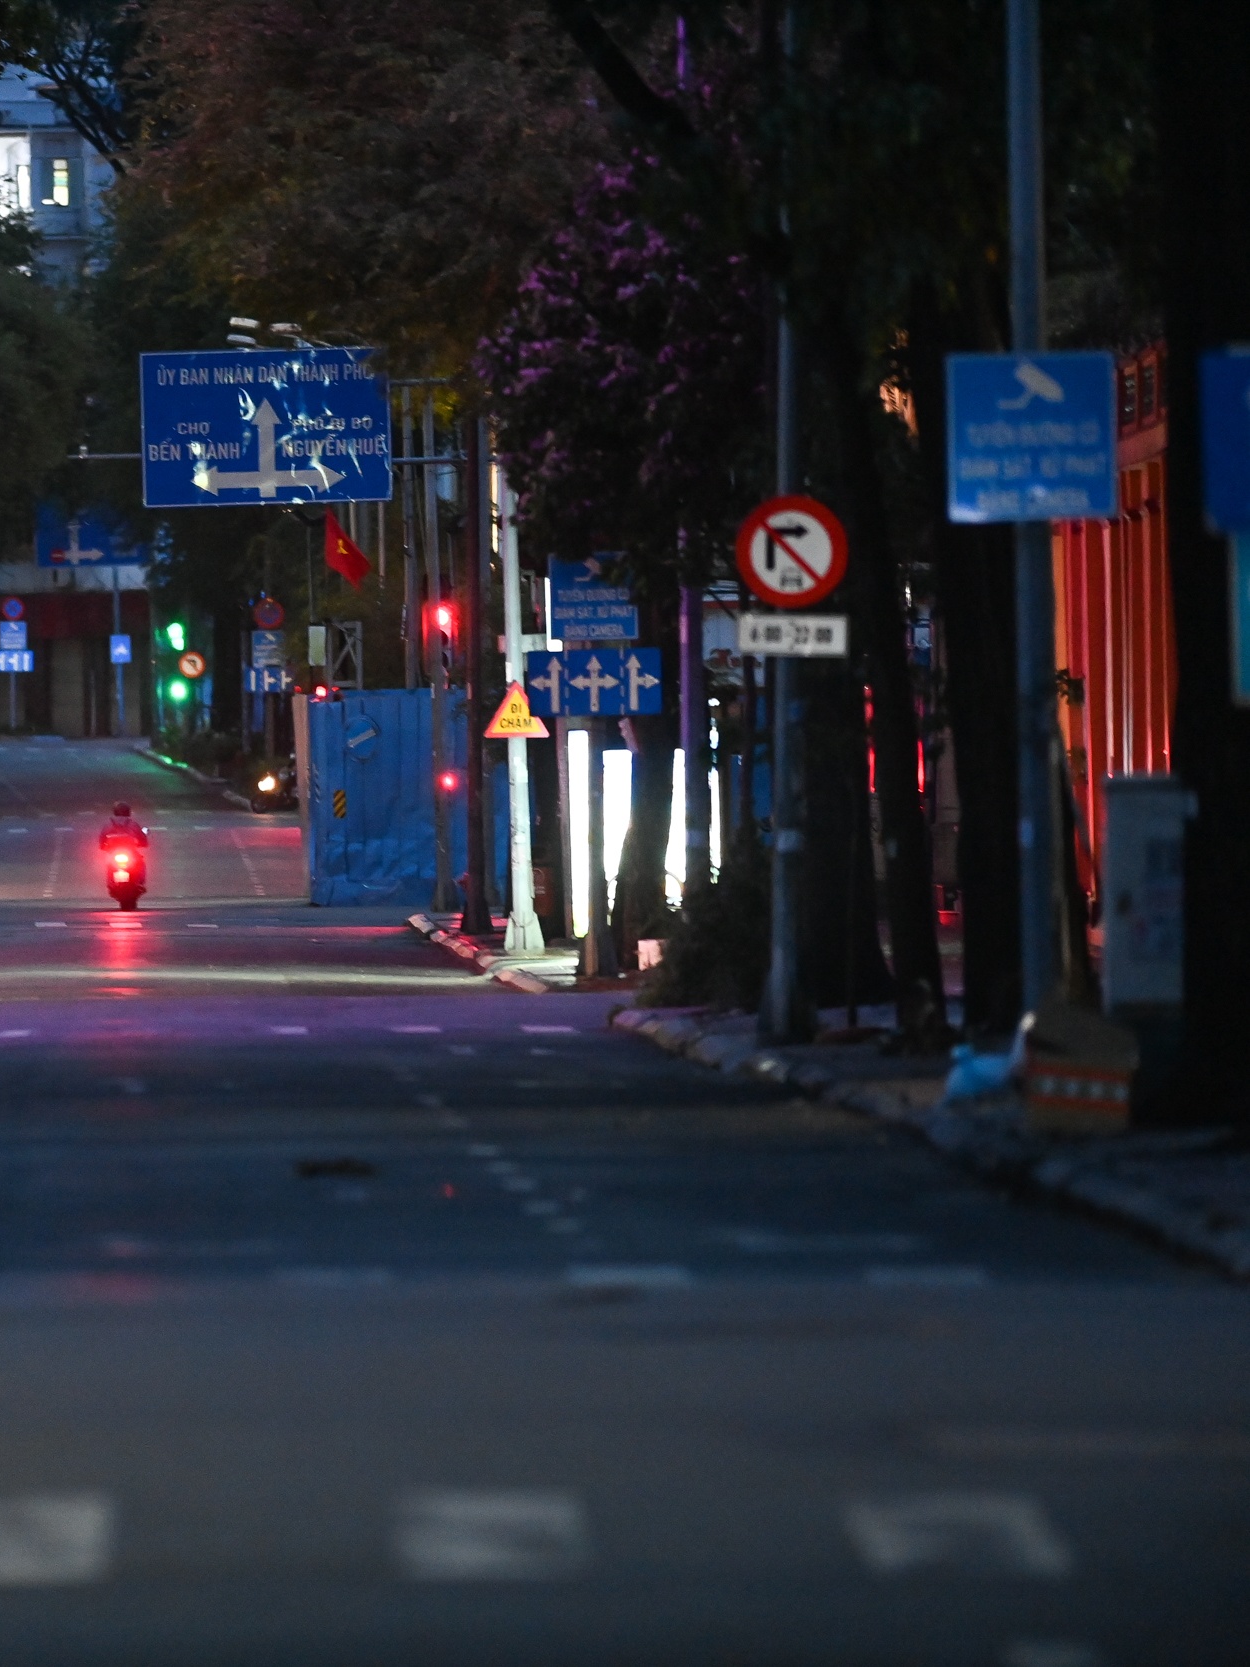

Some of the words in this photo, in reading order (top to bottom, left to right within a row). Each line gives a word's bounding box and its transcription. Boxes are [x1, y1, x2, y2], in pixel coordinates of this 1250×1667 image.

[157, 364, 176, 386] ỦY
[179, 367, 210, 386] BAN
[213, 363, 254, 385] NHÂN
[258, 361, 288, 384] DÂN
[292, 360, 339, 382] THÀNH
[177, 421, 211, 437] CHỢ
[351, 415, 373, 432] BỘ
[148, 438, 182, 462] BẾN
[186, 439, 240, 461] THÀNH
[281, 433, 348, 458] NGUYỄN
[352, 433, 386, 457] HUỆ
